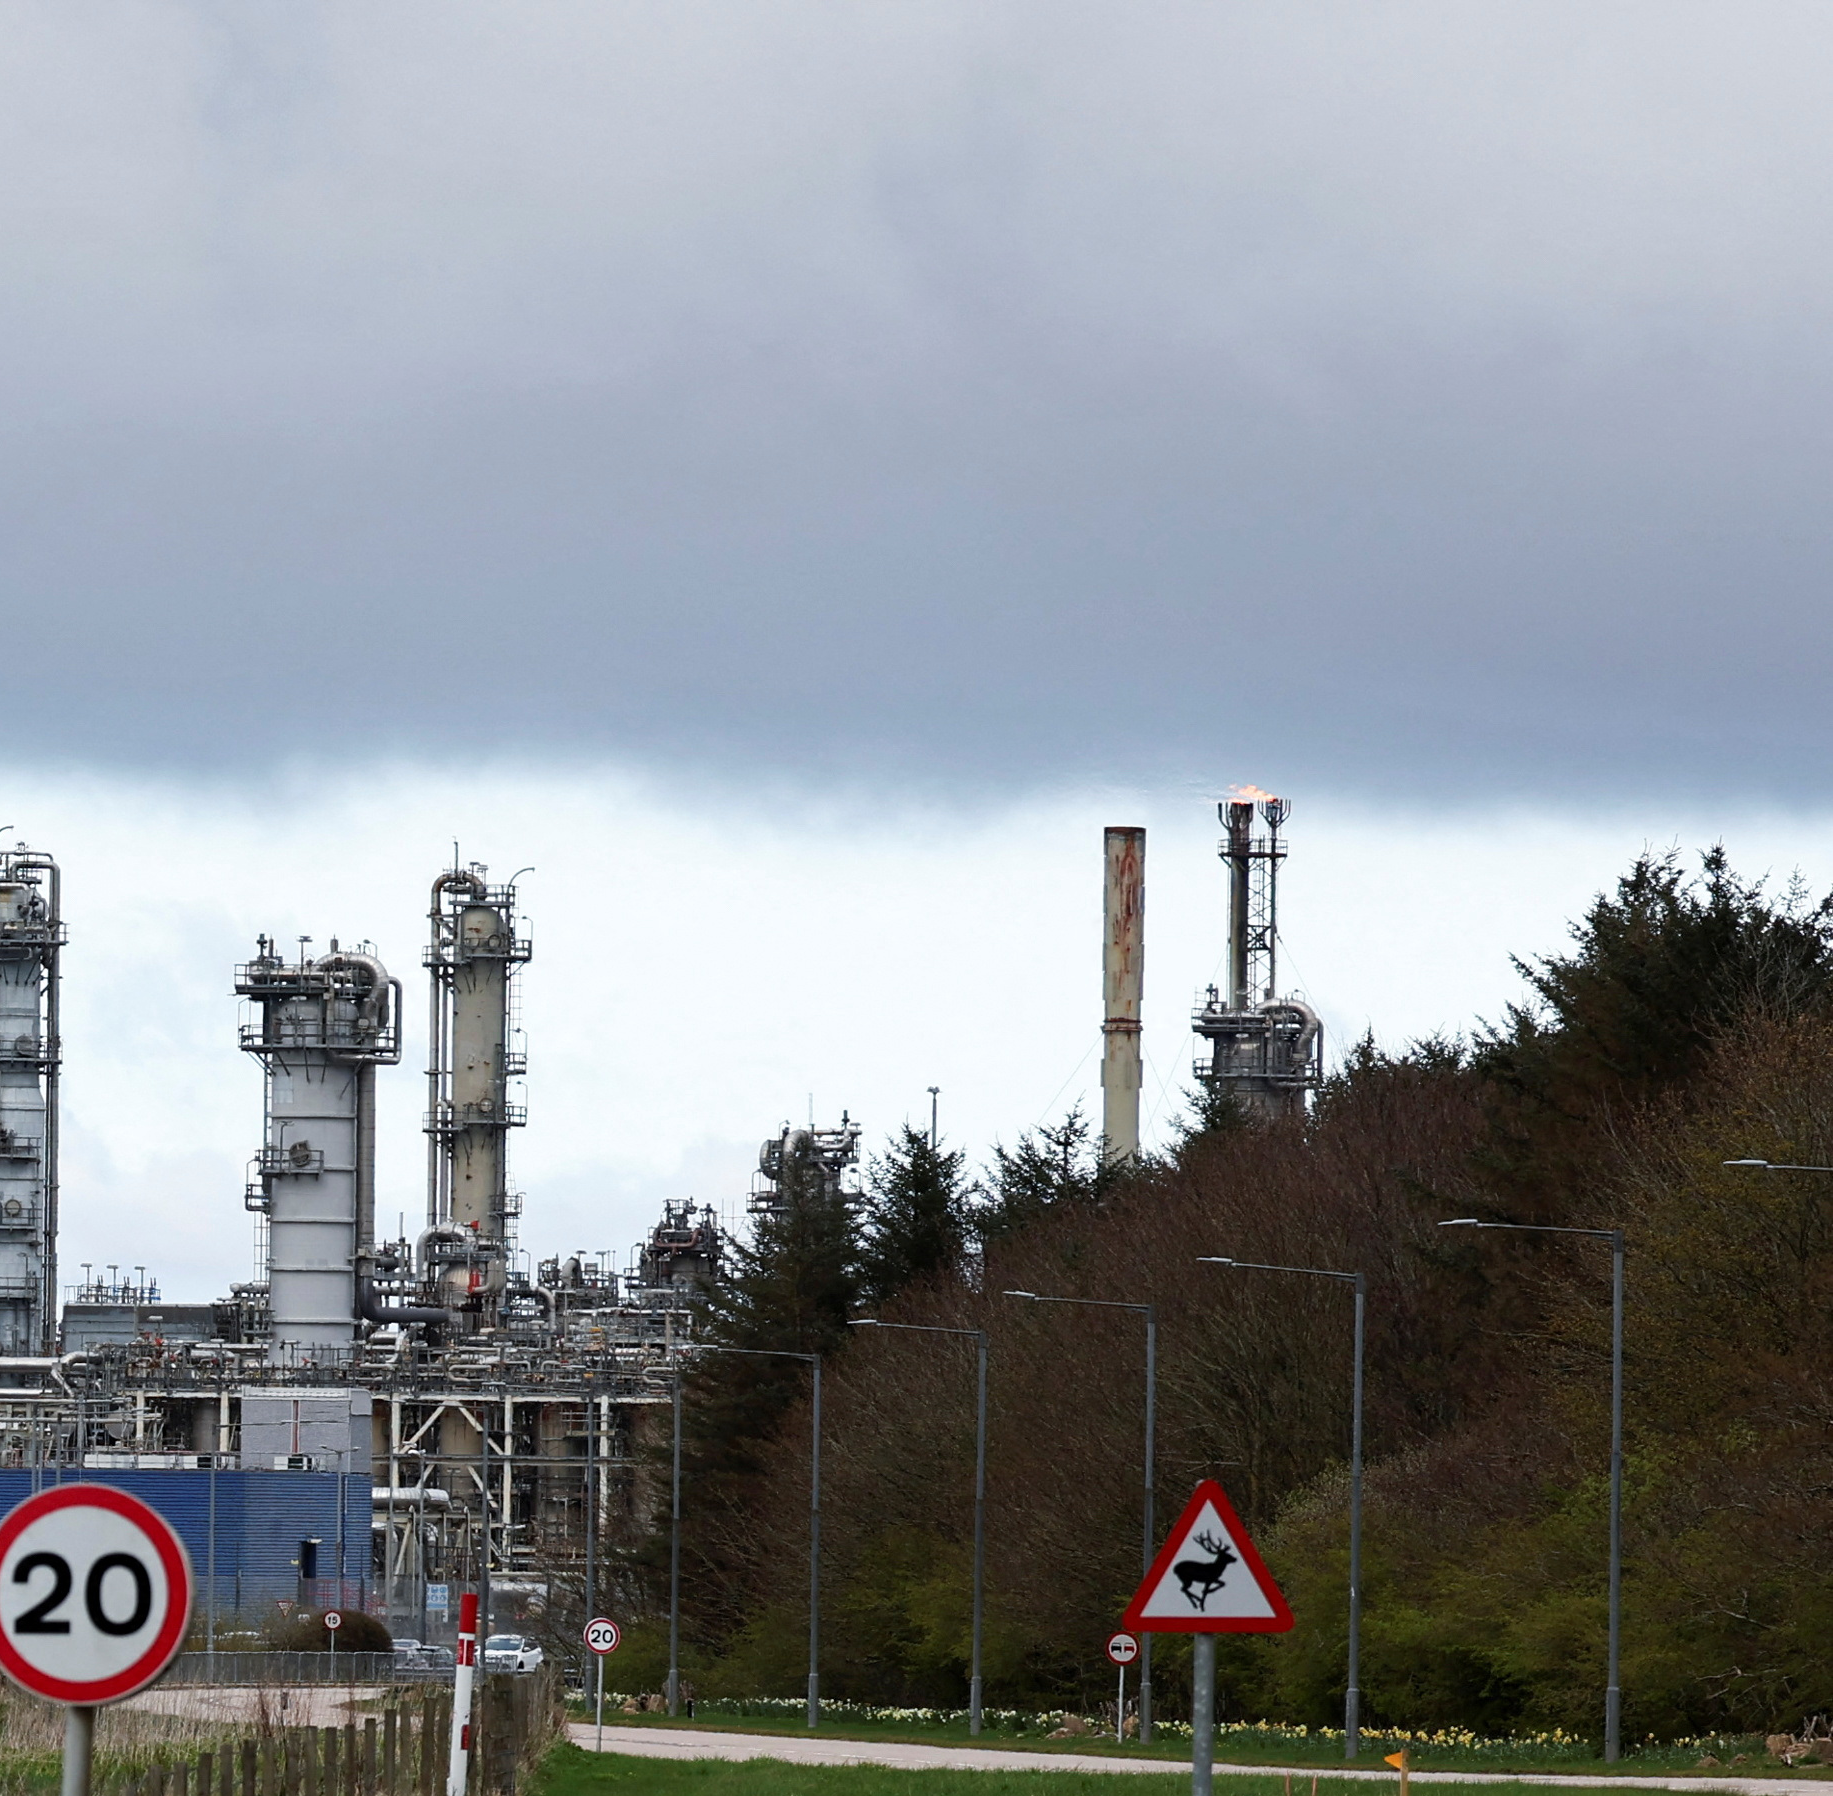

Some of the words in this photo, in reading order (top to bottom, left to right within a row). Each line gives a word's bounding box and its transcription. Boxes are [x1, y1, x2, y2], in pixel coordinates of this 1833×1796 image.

[12, 1551, 152, 1636] 20
[327, 1615, 338, 1625] 15
[590, 1629, 614, 1644] 20
